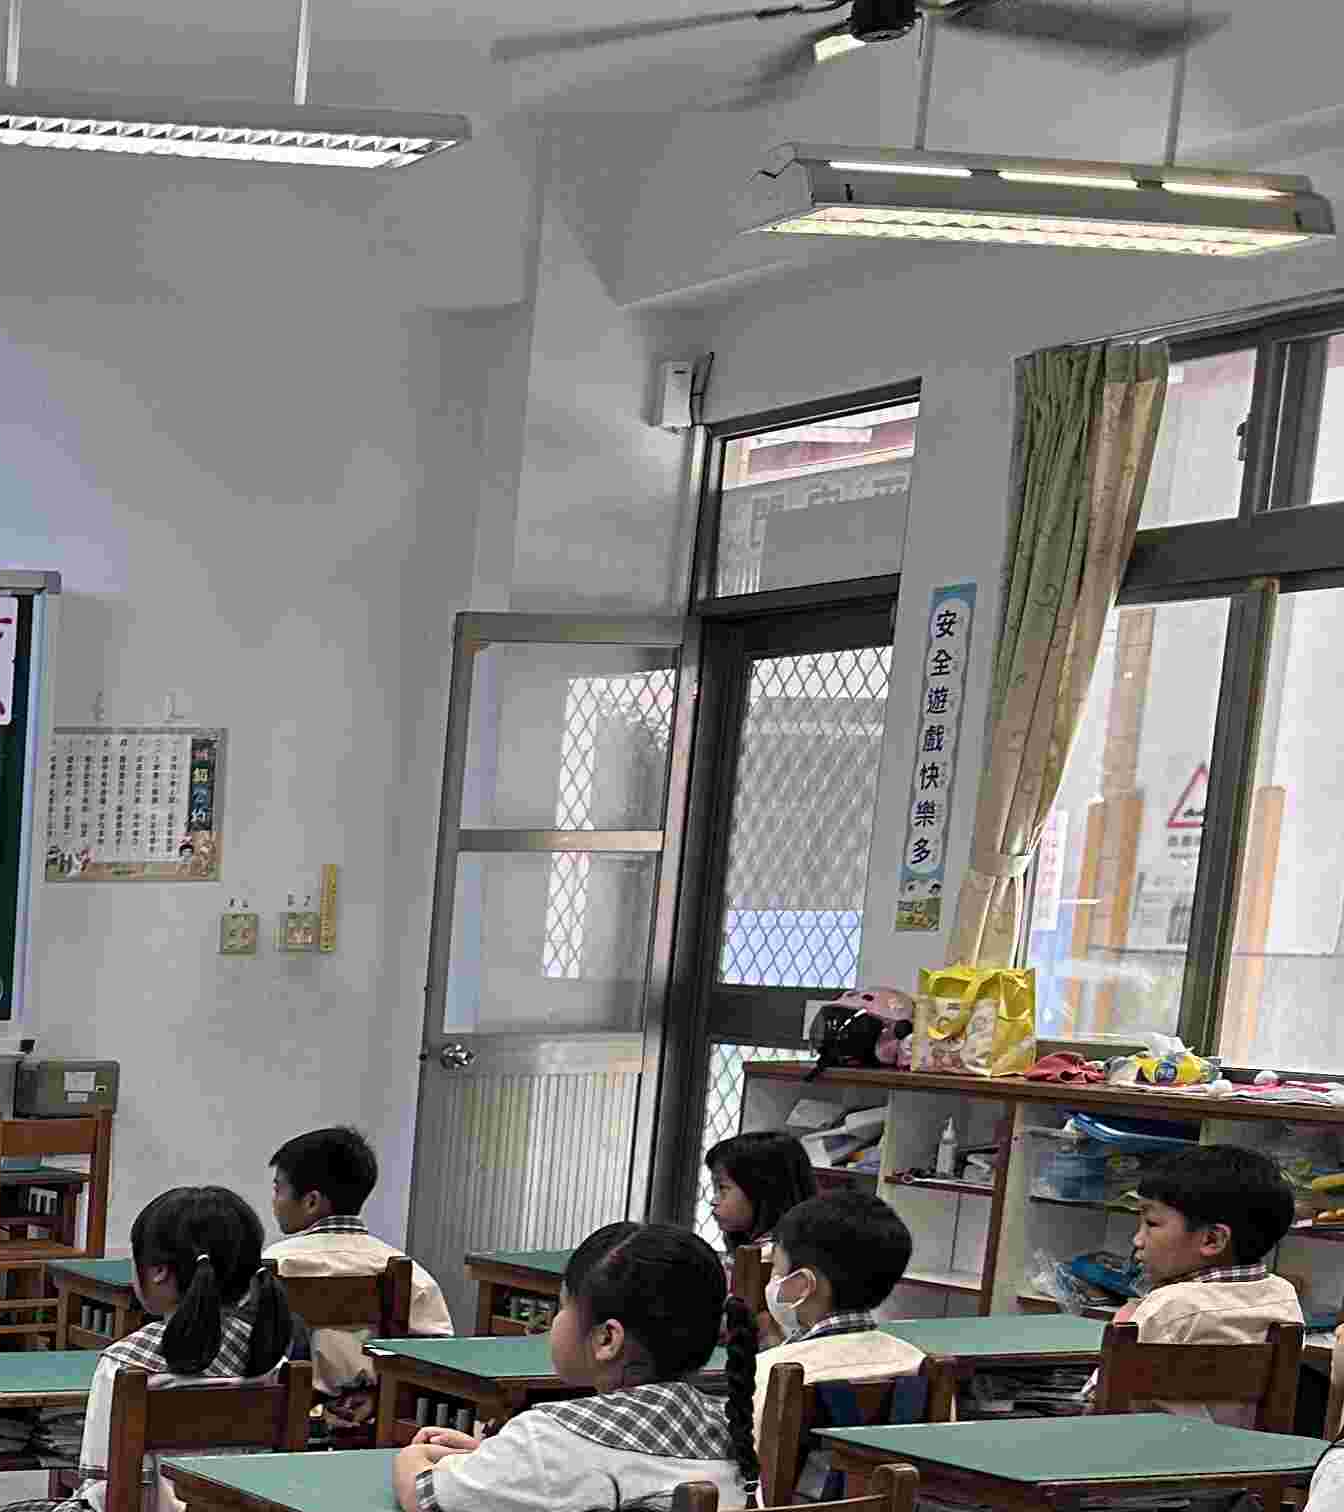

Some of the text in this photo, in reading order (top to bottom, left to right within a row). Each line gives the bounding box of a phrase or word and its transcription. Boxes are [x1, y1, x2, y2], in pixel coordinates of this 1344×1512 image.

[911, 608, 958, 865] 安全遊戲快樂多
